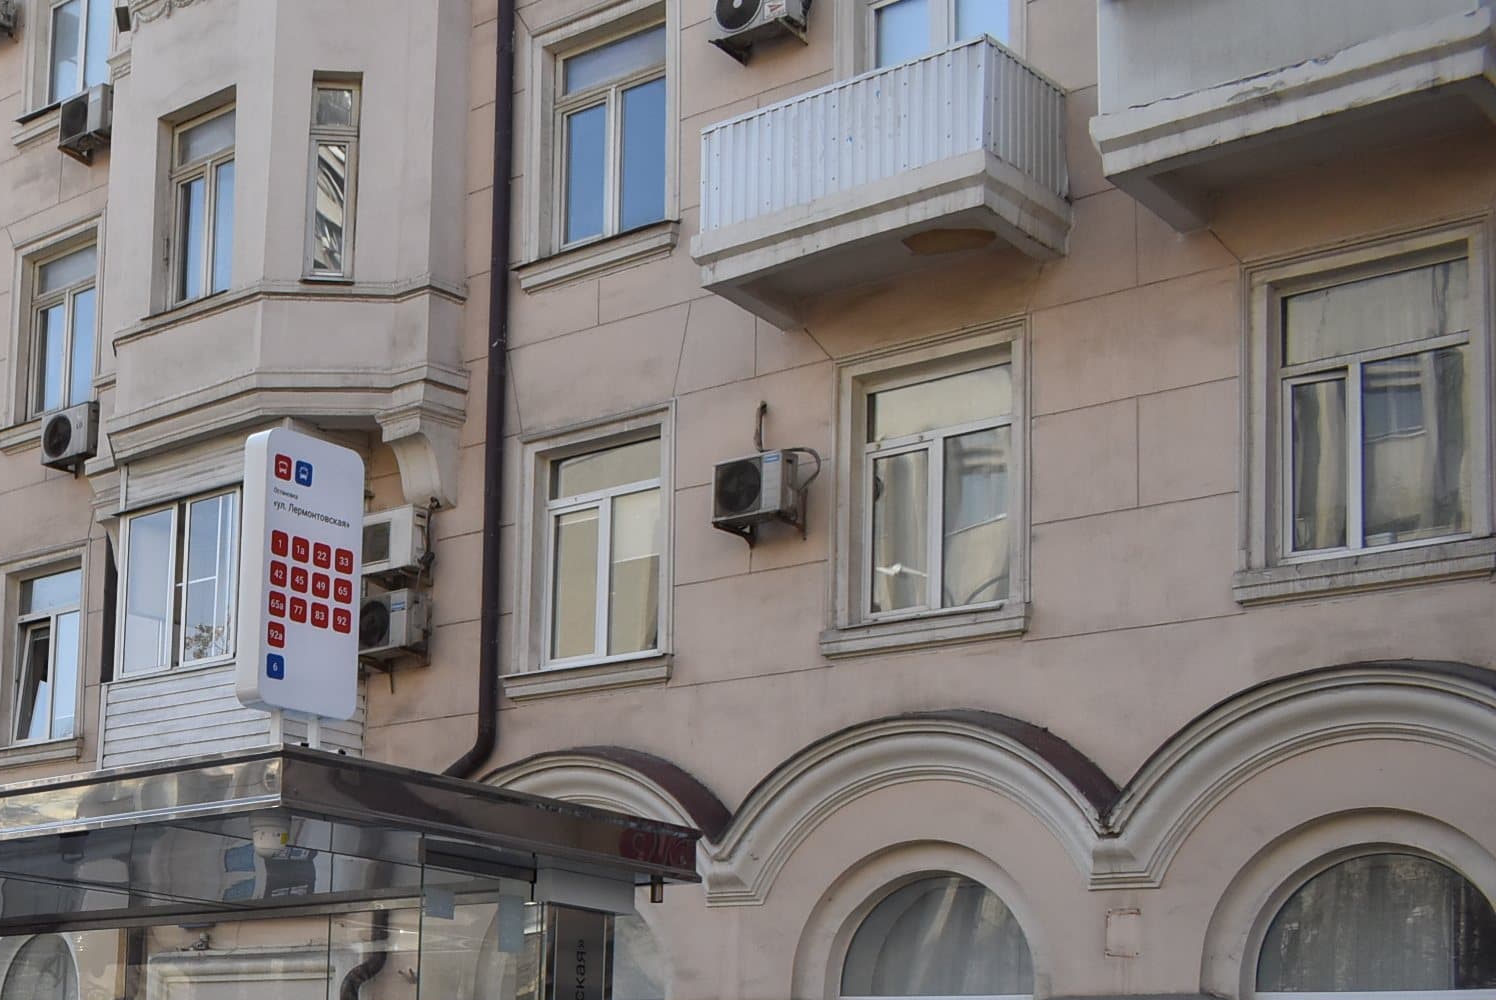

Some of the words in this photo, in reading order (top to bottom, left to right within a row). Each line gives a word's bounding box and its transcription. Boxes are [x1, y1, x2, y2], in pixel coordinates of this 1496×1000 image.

[278, 538, 283, 549] 1
[317, 551, 327, 561] 22
[338, 556, 349, 567] 33
[273, 569, 284, 580] 42
[294, 575, 305, 585] 45
[316, 581, 326, 591] 49
[337, 586, 348, 597] 65
[293, 604, 304, 616] 77
[314, 610, 325, 621] 83
[336, 615, 347, 626] 92
[272, 662, 279, 672] 6
